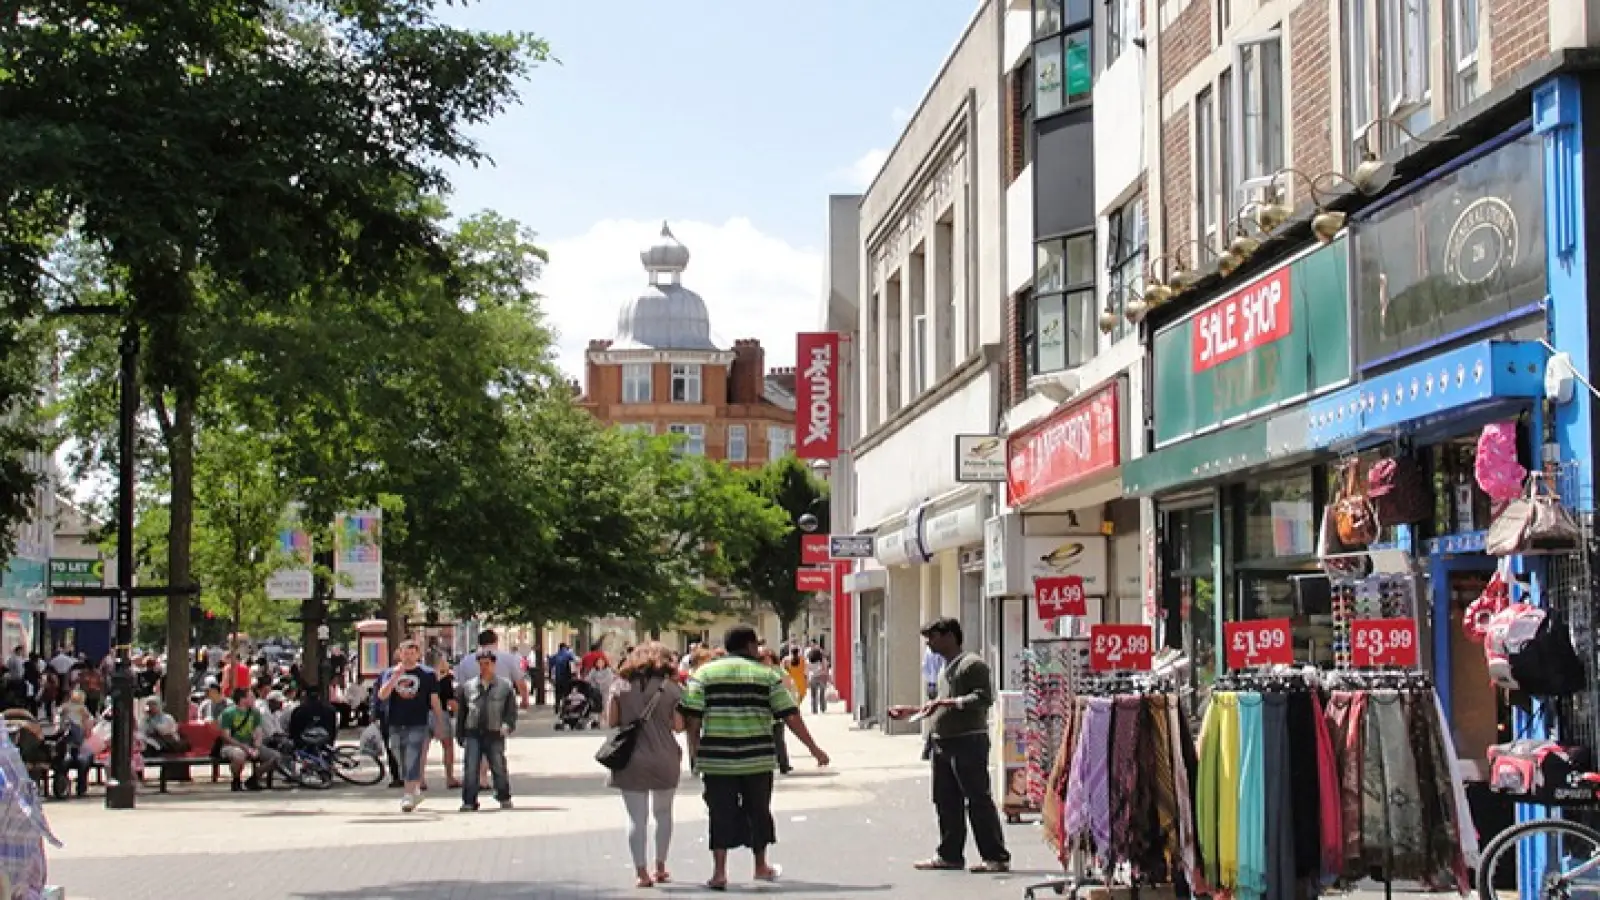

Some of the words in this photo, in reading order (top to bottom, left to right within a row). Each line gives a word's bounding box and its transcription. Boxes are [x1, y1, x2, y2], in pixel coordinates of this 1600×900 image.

[1200, 302, 1239, 361] SALE
[1242, 280, 1281, 341] SHOP
[51, 562, 66, 573] TO
[68, 562, 90, 573] LET
[1038, 584, 1082, 611] £4.99
[1095, 633, 1149, 661] £2.99
[1233, 628, 1285, 657] £1.99
[1355, 628, 1412, 656] £3.99
